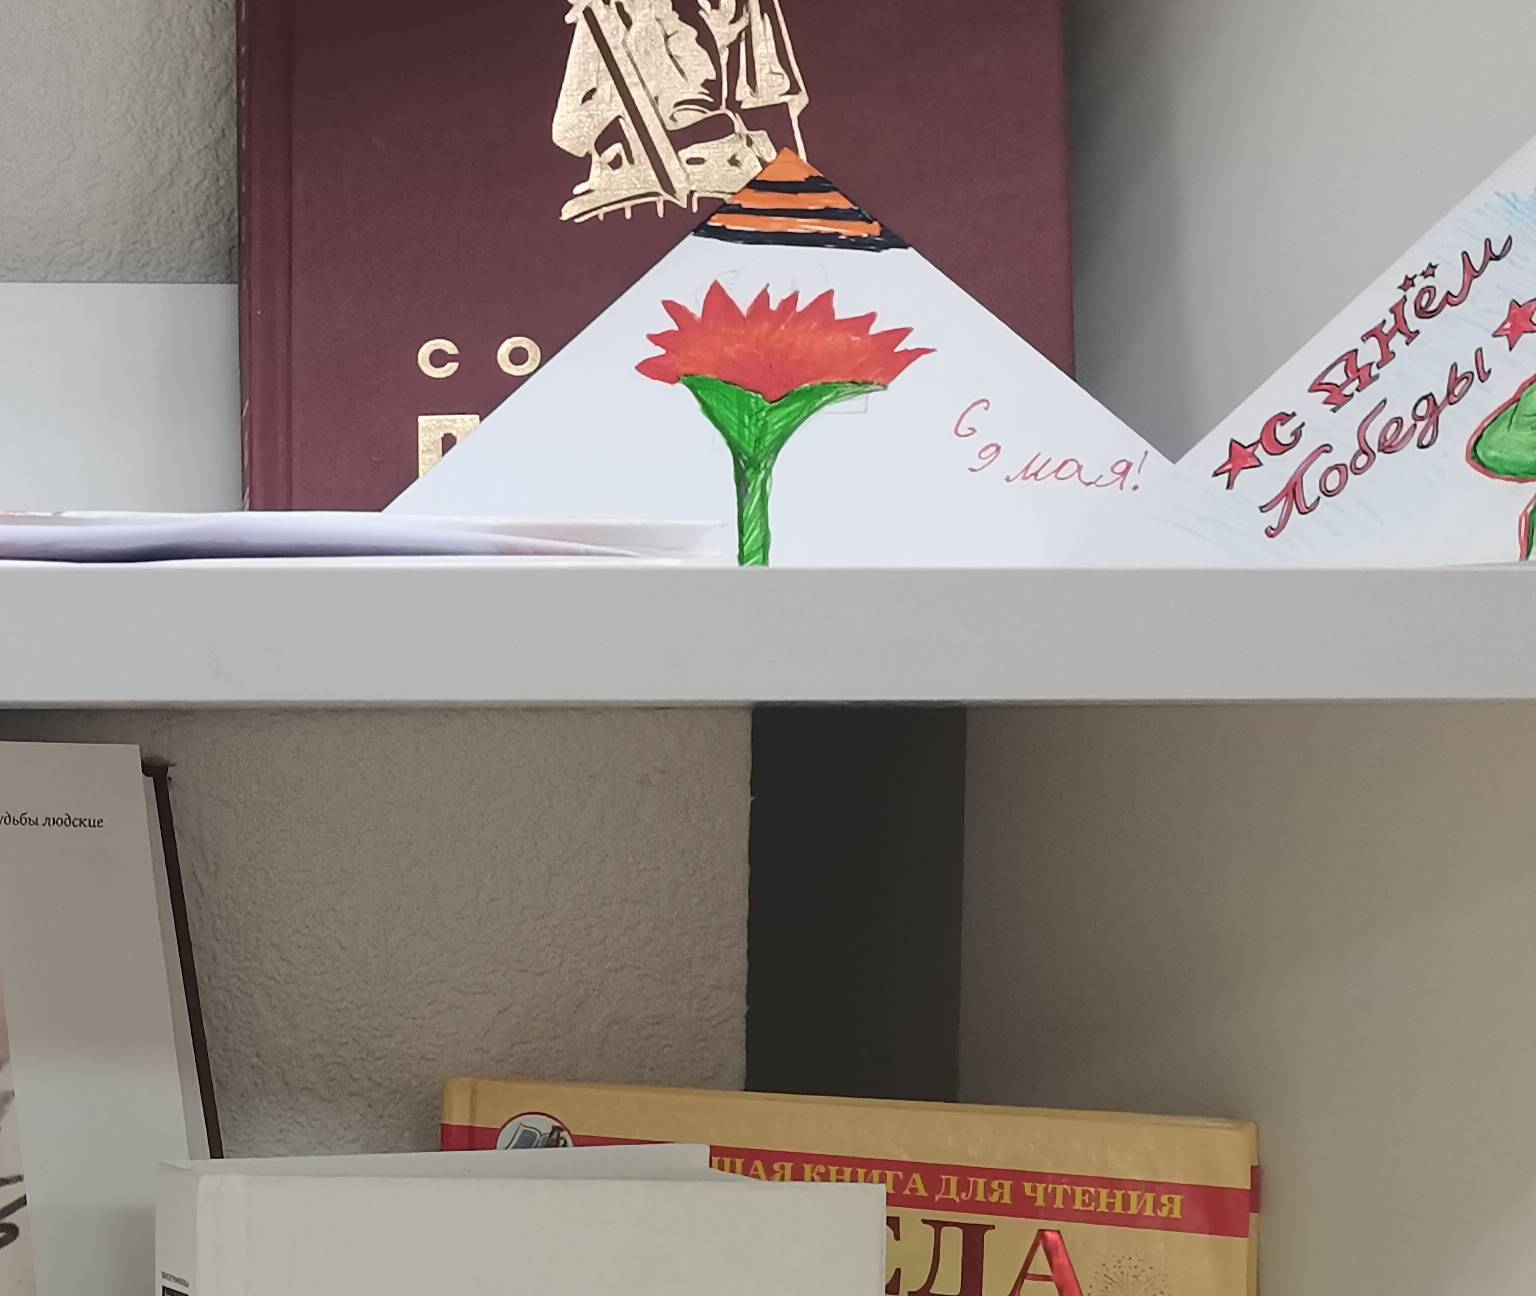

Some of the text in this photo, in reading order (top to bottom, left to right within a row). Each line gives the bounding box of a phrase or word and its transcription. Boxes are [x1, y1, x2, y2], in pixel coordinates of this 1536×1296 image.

[42, 813, 104, 829] людские
[935, 1175, 1013, 1205] ДЛЯ
[1023, 1184, 1184, 1219] ЧТЕНИЯ
